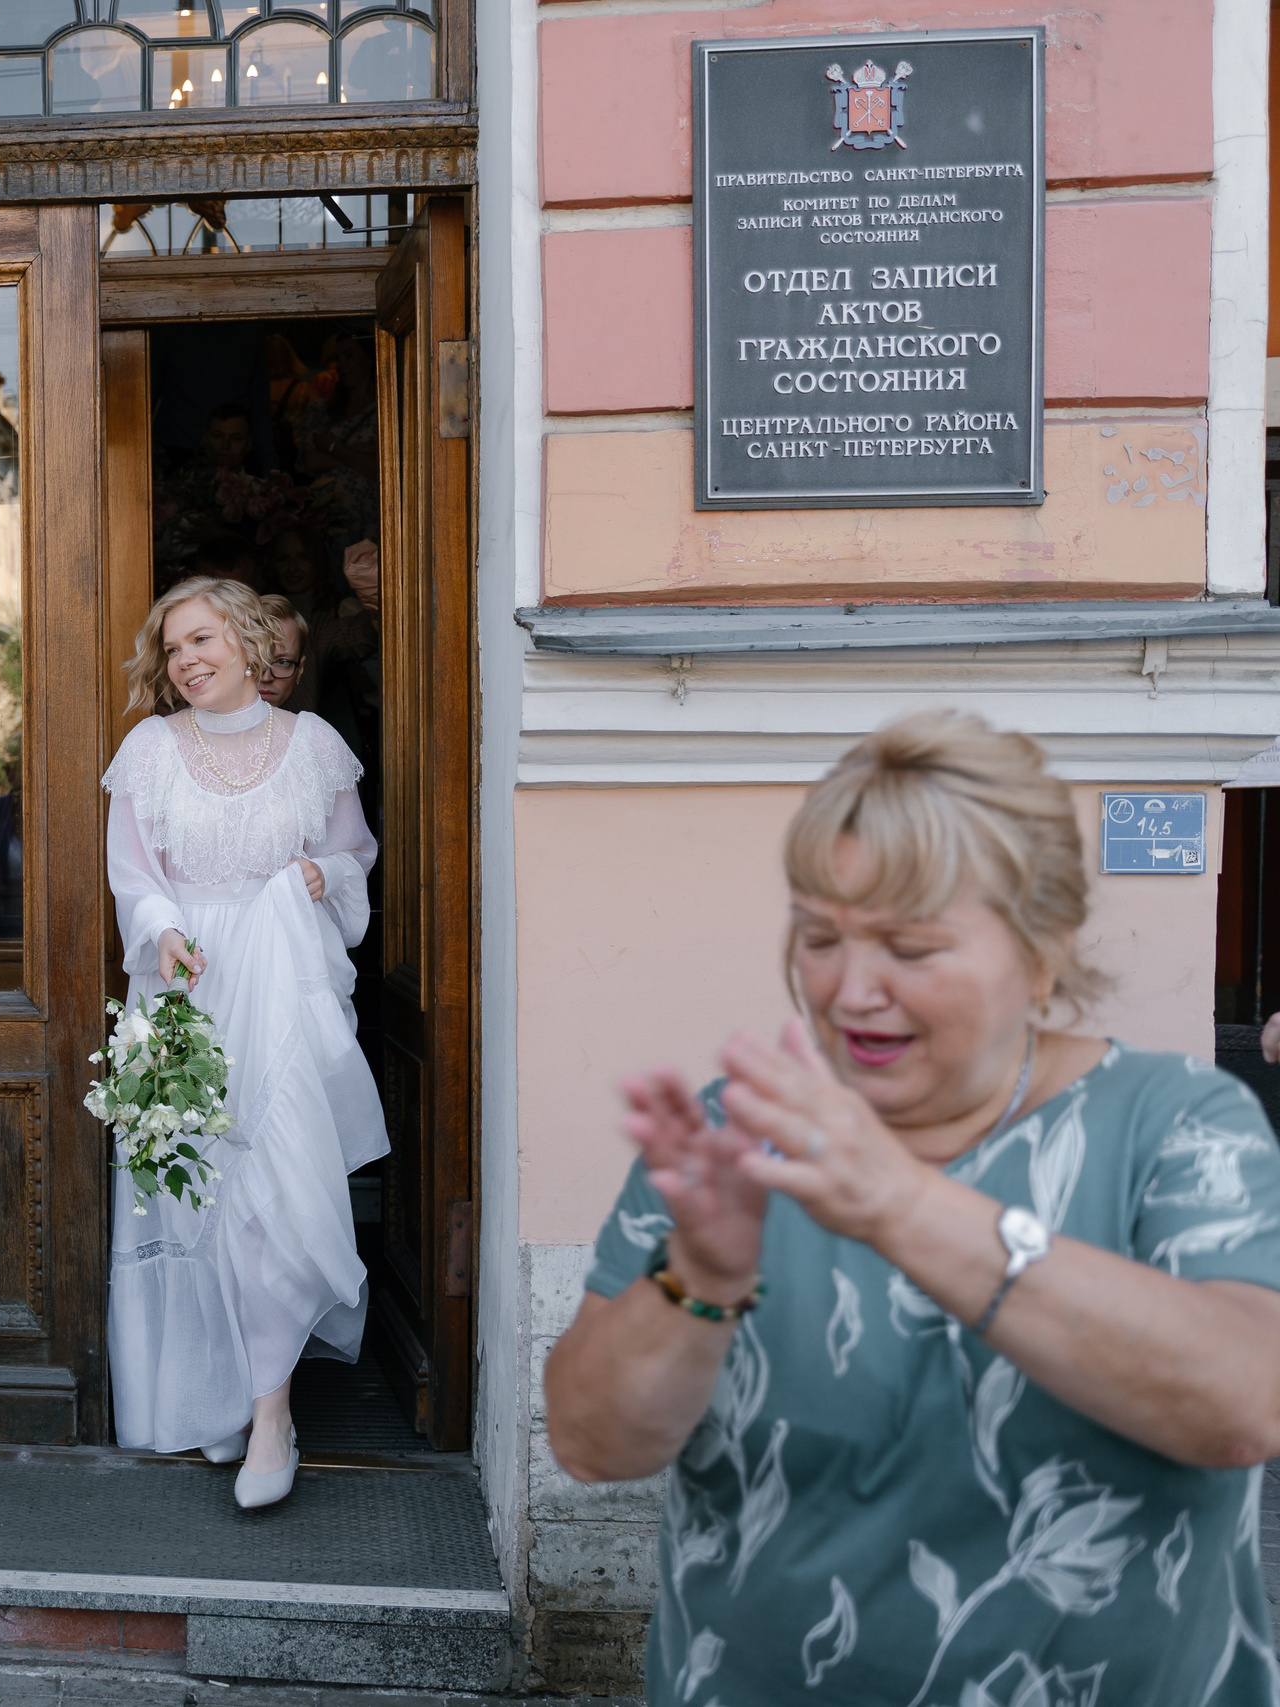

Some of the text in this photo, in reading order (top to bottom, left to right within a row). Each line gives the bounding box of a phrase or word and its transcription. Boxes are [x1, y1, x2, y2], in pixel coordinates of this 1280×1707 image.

[716, 164, 1024, 187] ПРАВИТЕЛЬСТВО САНКТ-ПЕТЕРБУРГА
[783, 195, 956, 212] КОМИТЕТ ПО ДЕЛАМ
[737, 211, 1002, 230] ЗАПИСИ АКТОВ ГРАЖДАНСКОГО
[820, 231, 919, 244] СОСТОЯНИЯ
[744, 265, 997, 296] ОТДЕЛ ЗАПИСИ
[819, 302, 922, 325] АКТОВ
[739, 334, 1001, 363] ГРАЖДАНСКОГО
[774, 369, 967, 394] СОСТОЯНИЯ
[722, 412, 1018, 439] ЦЕНТРАЛЬНОГО РАЙОНА
[1137, 817, 1172, 836] 14.5
